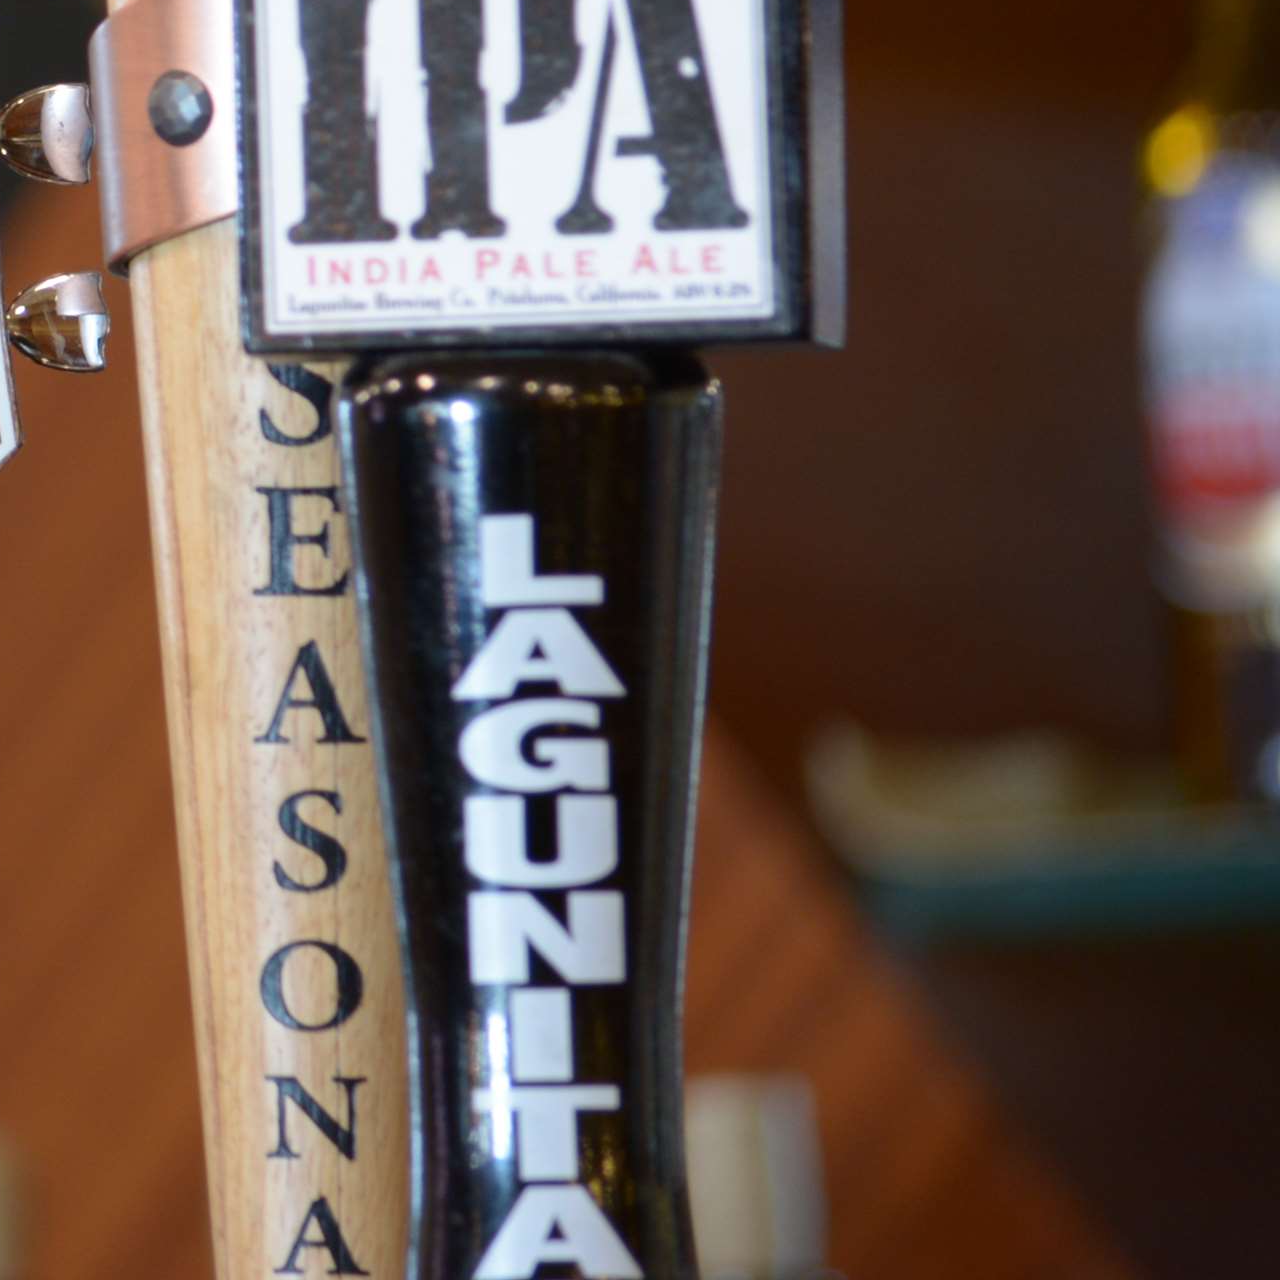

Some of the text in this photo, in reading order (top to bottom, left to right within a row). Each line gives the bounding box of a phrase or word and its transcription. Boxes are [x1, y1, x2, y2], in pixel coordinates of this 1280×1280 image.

[306, 243, 723, 287] INDIA PALE ALE
